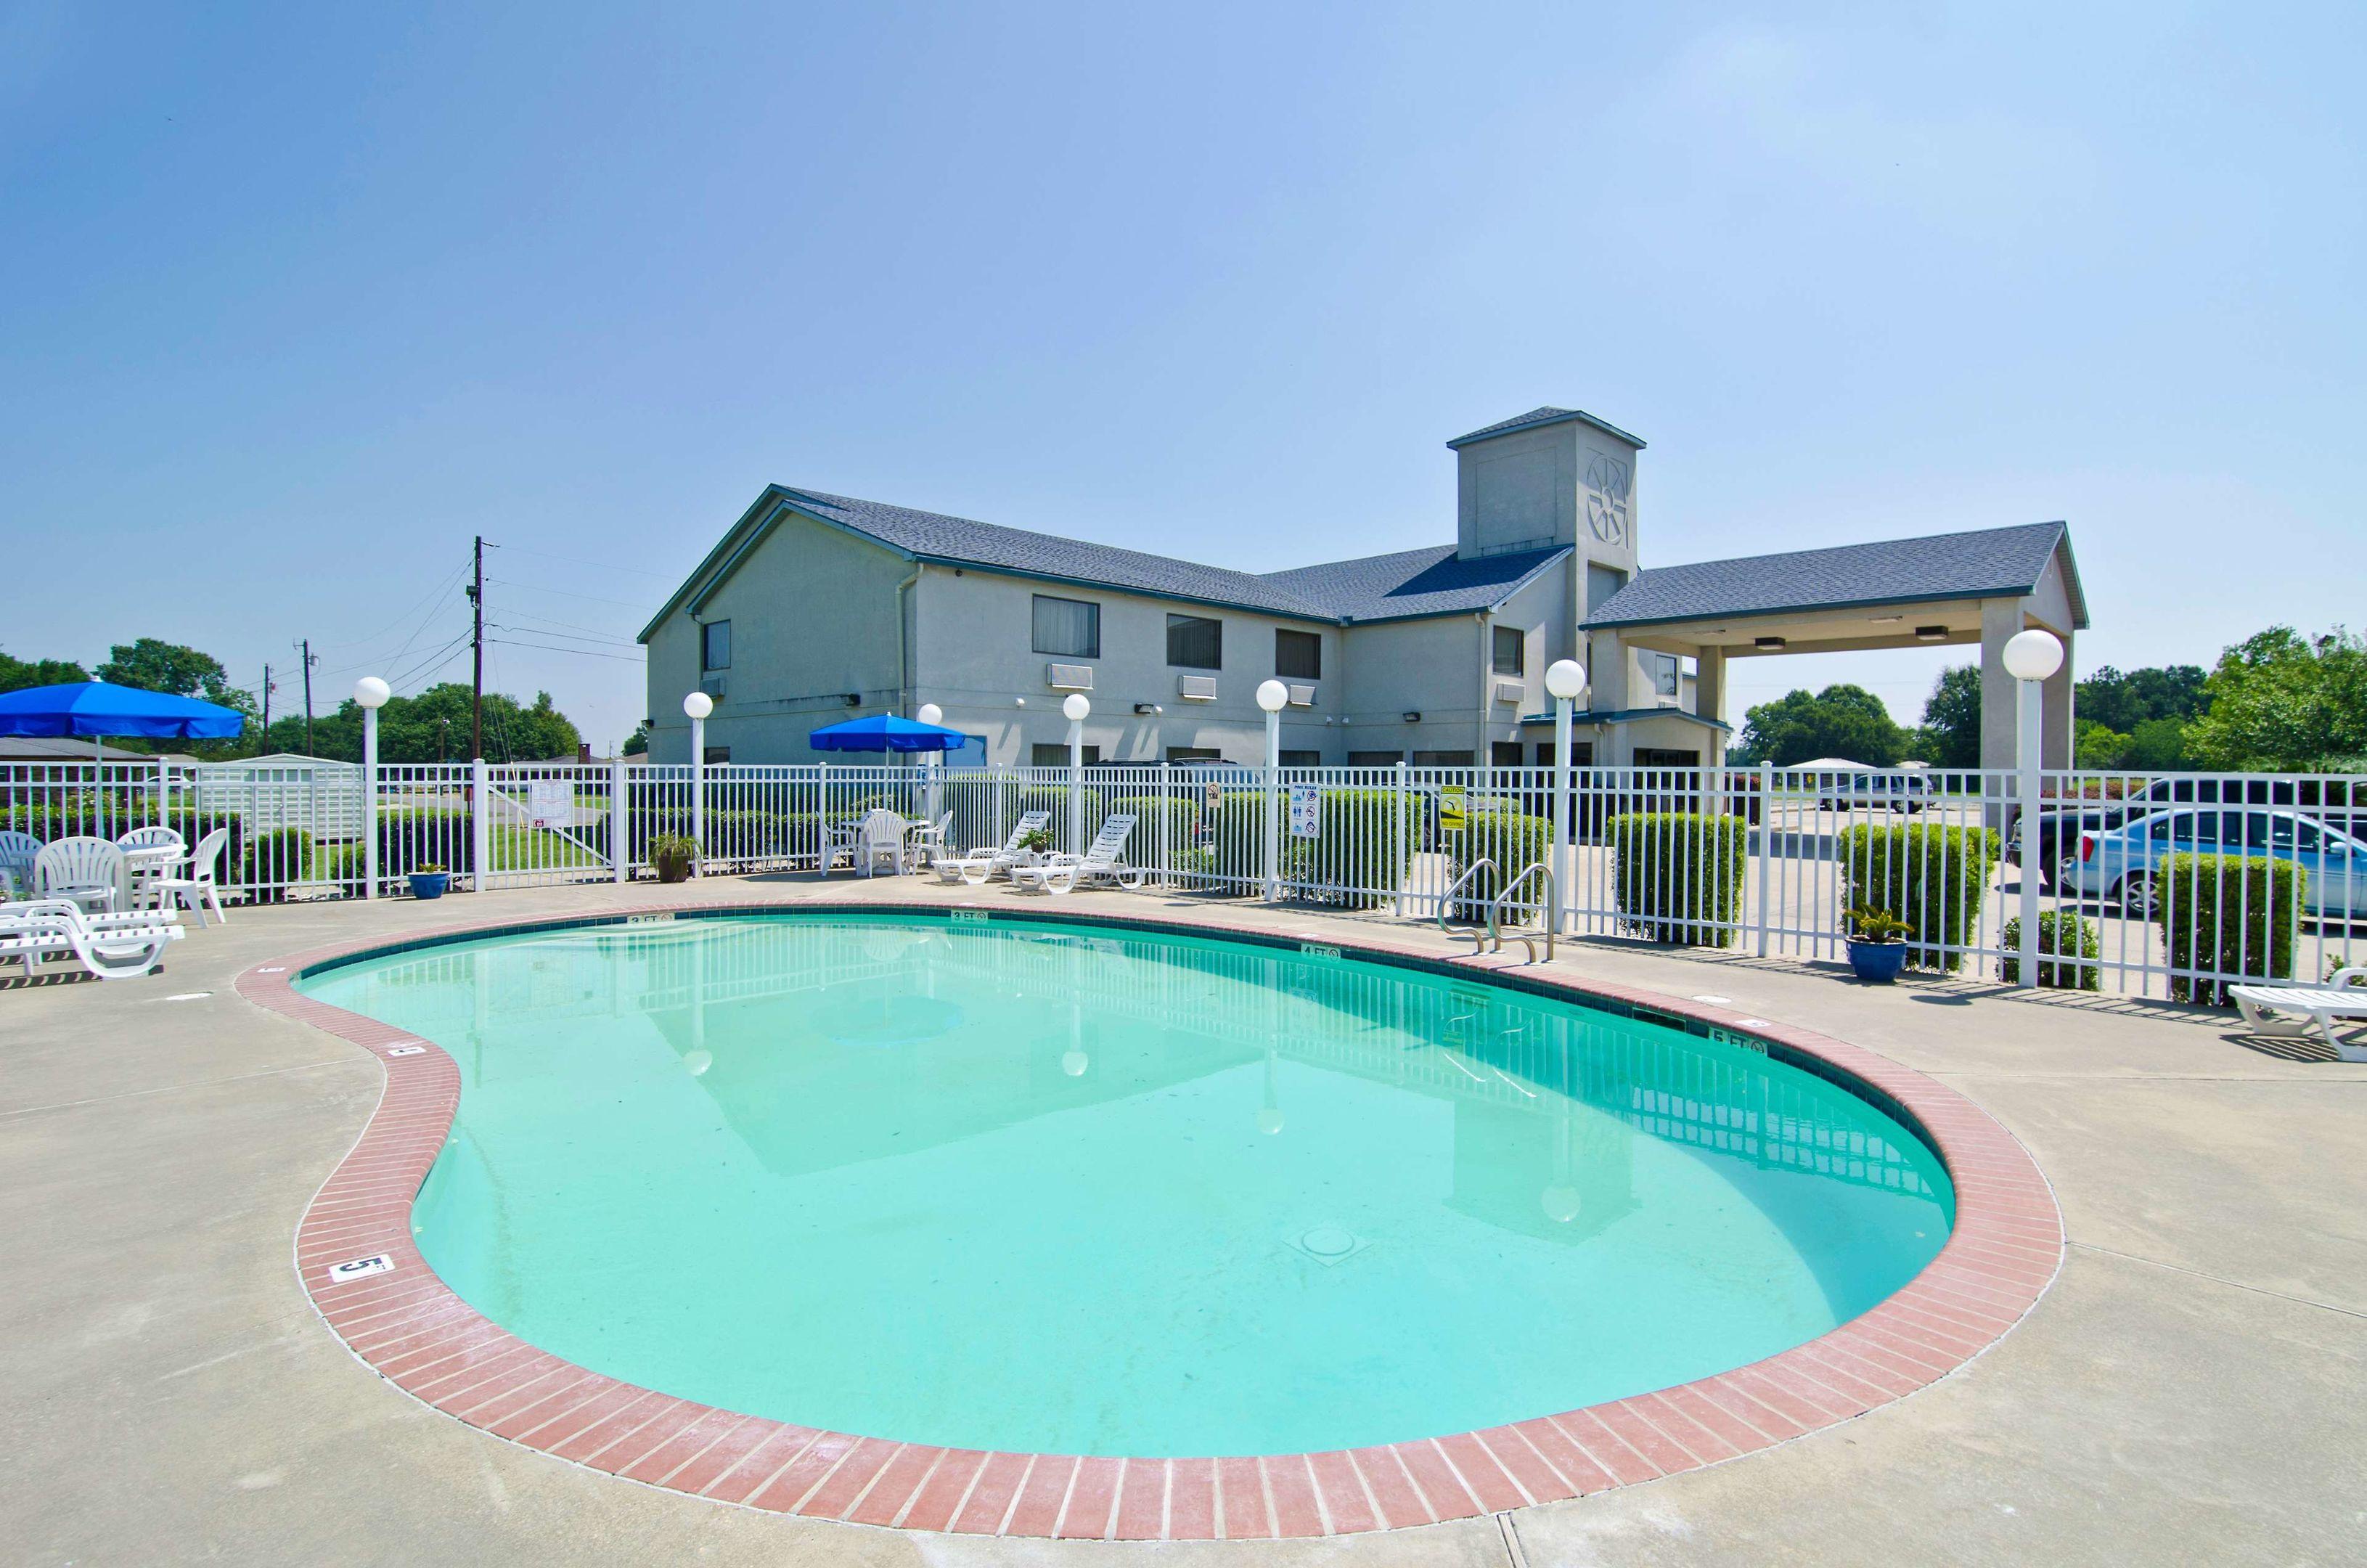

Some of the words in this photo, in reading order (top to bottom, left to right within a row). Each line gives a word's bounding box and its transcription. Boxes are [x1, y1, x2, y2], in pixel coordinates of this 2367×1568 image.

[1714, 1029, 1723, 1042] 5
[1730, 1035, 1746, 1048] FT
[339, 1257, 383, 1272] 5
